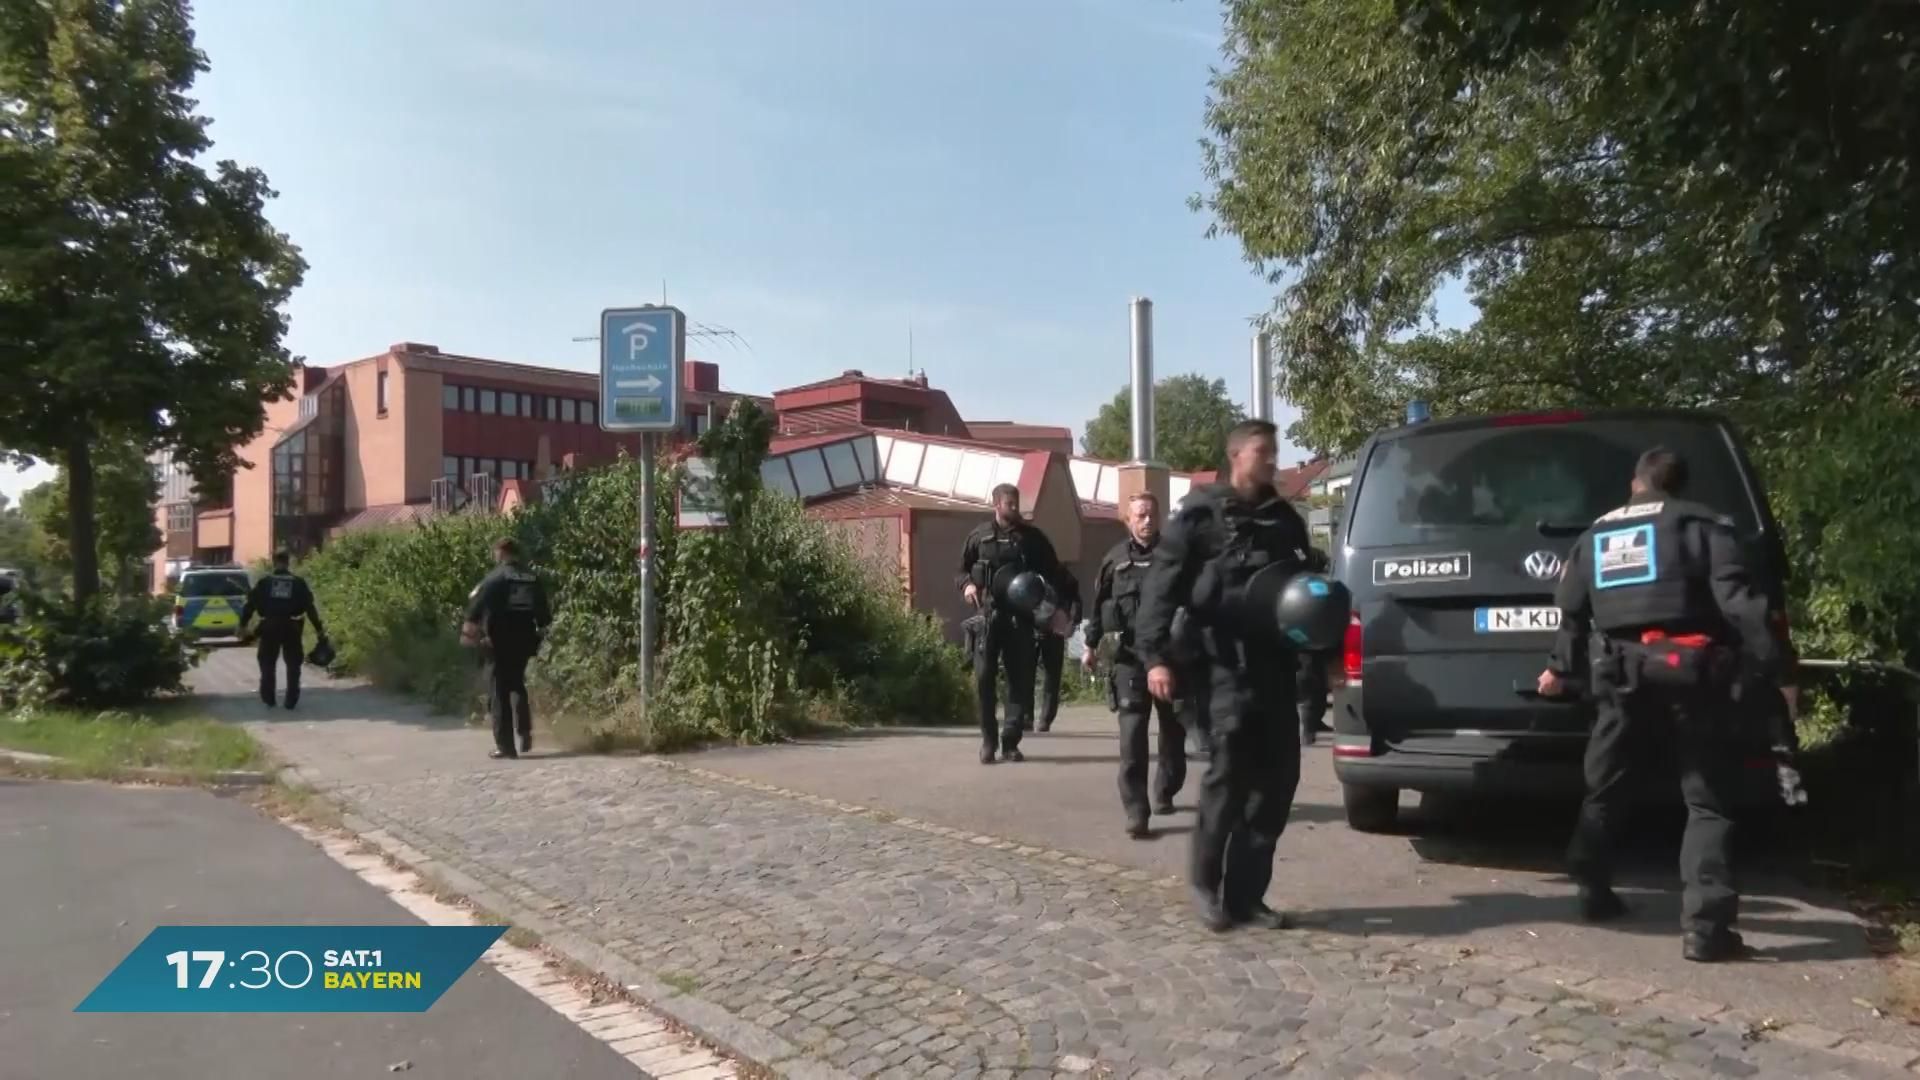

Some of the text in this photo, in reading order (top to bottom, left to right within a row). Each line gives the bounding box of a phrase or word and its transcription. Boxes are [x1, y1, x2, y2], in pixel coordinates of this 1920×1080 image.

[630, 334, 648, 360] P
[1384, 557, 1460, 578] Polizei
[1496, 611, 1510, 627] N
